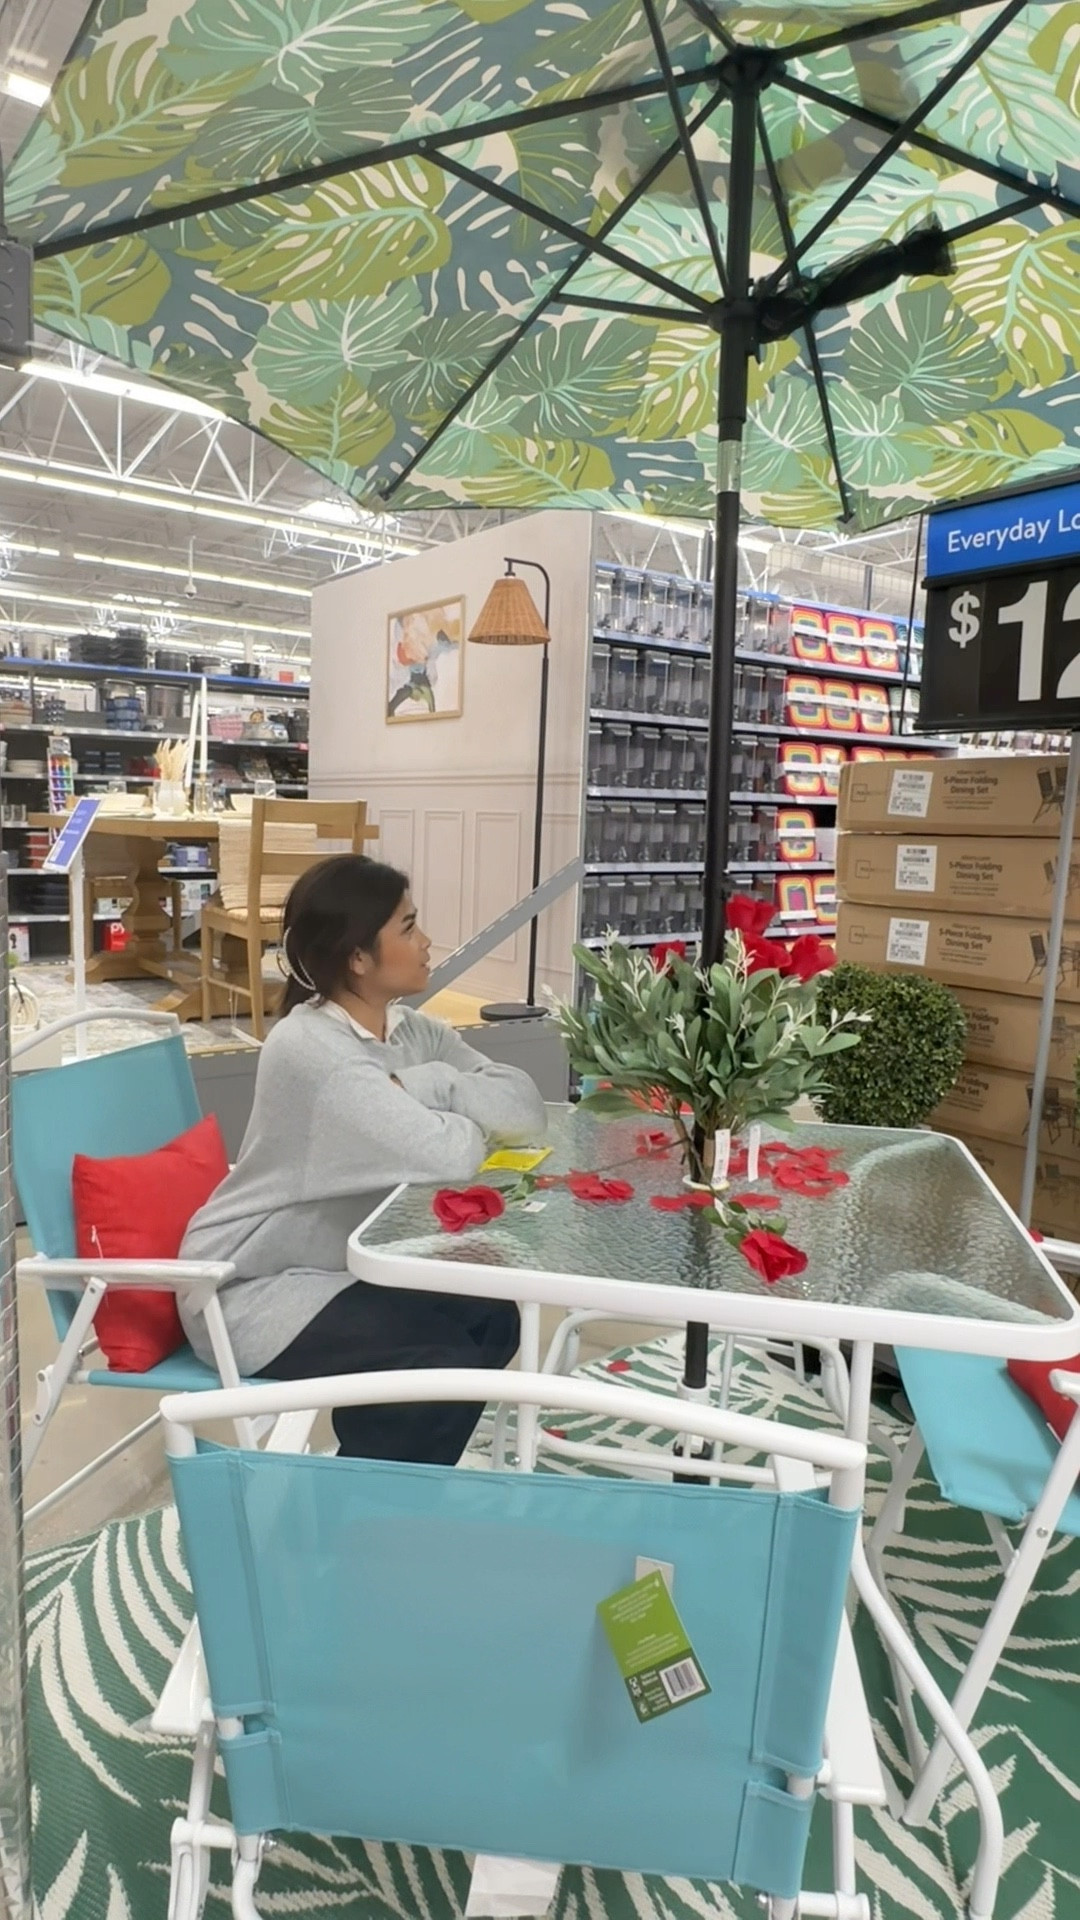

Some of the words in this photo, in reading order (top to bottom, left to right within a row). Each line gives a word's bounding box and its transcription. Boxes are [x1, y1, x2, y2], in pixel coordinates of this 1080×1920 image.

[948, 516, 1051, 553] Everyday
[970, 775, 998, 786] Folding
[976, 786, 989, 794] Set
[975, 861, 1003, 873] Folding
[981, 872, 993, 880] Set
